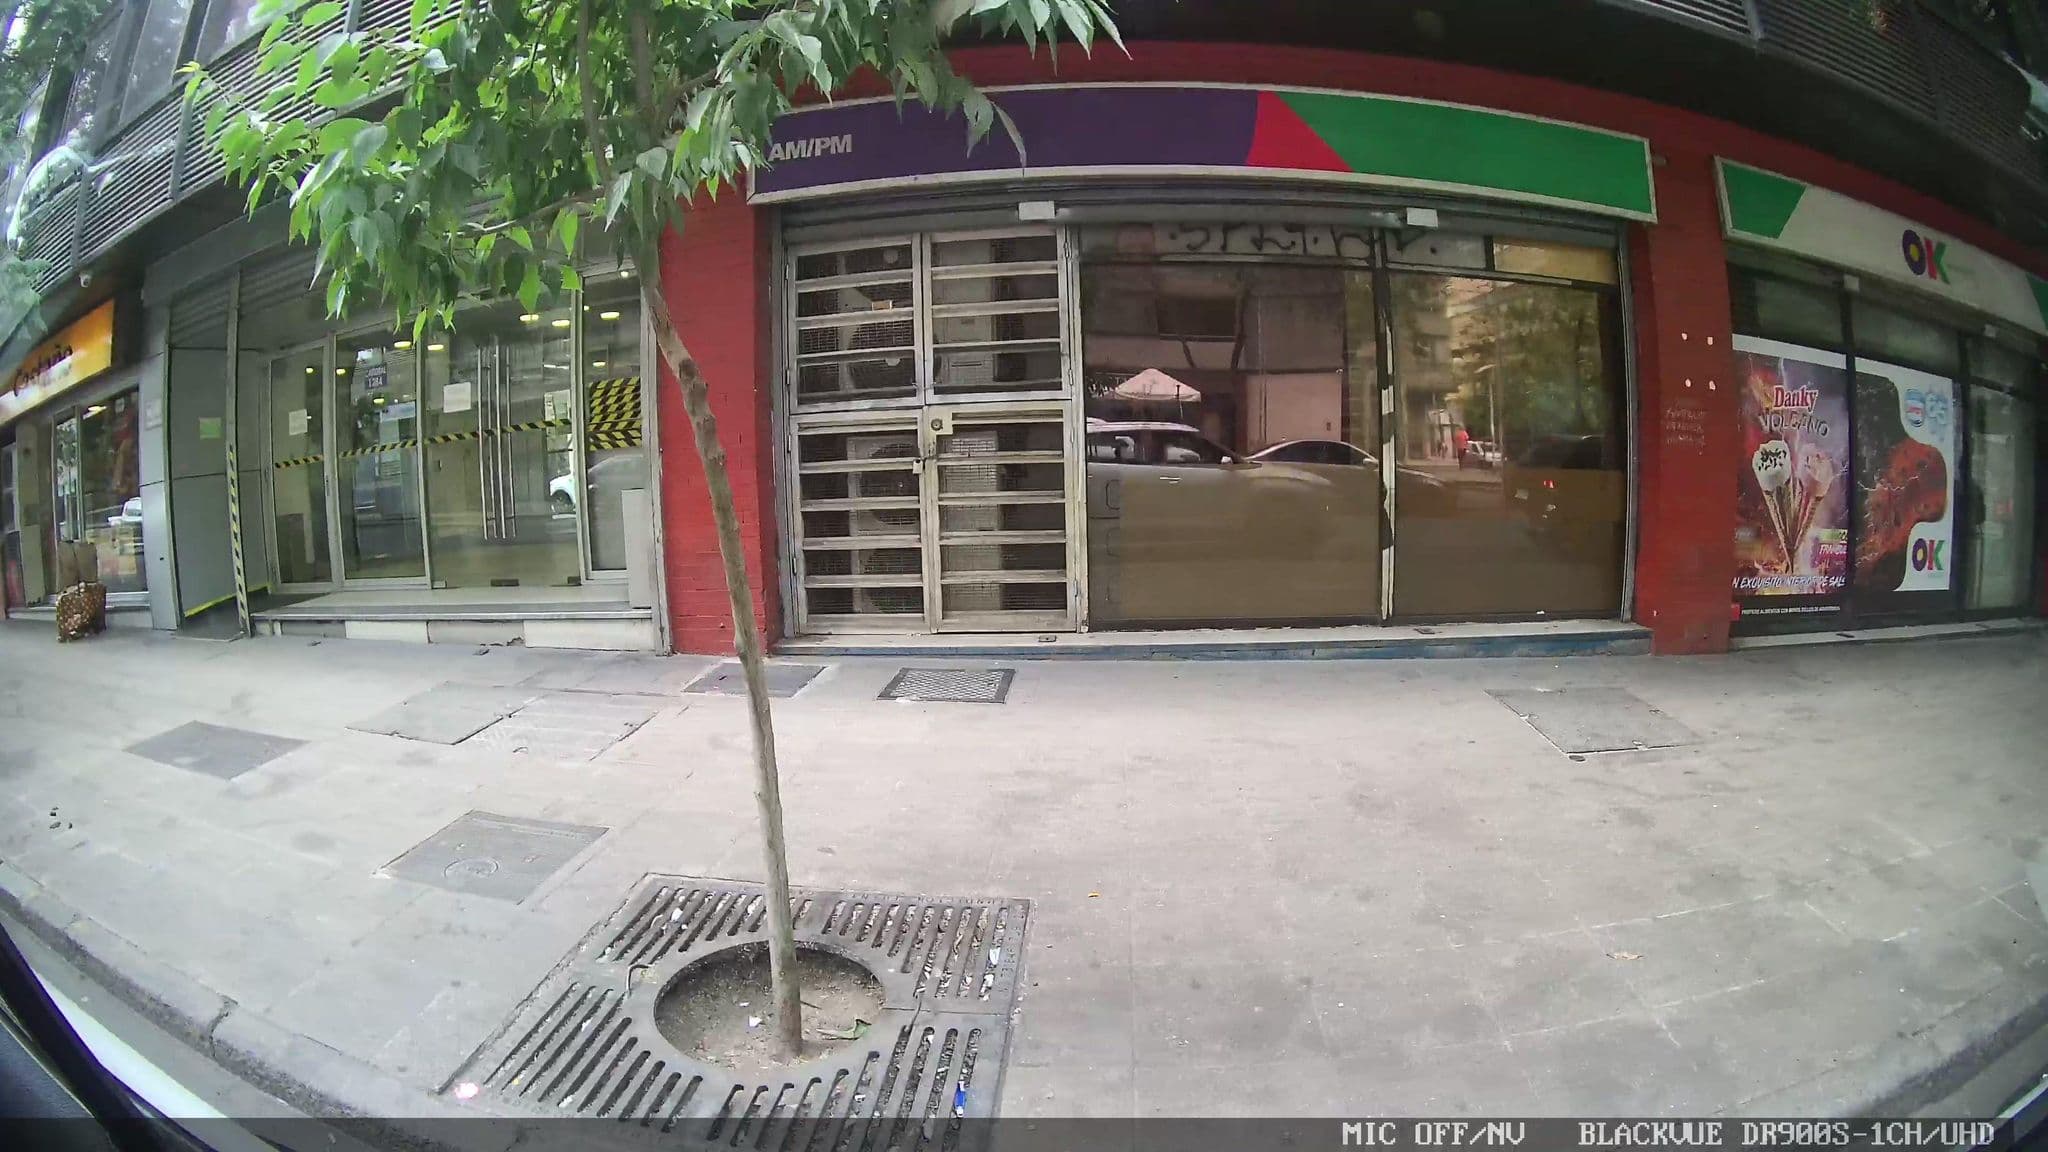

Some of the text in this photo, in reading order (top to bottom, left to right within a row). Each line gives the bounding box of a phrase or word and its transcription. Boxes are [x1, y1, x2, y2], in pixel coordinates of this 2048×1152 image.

[767, 134, 852, 162] AM/PM
[1902, 230, 1951, 285] OK
[1772, 384, 1819, 414] Danky
[1758, 409, 1830, 437] VOLCANO
[1912, 538, 1945, 571] OK
[1740, 575, 1782, 589] EXQUISITO
